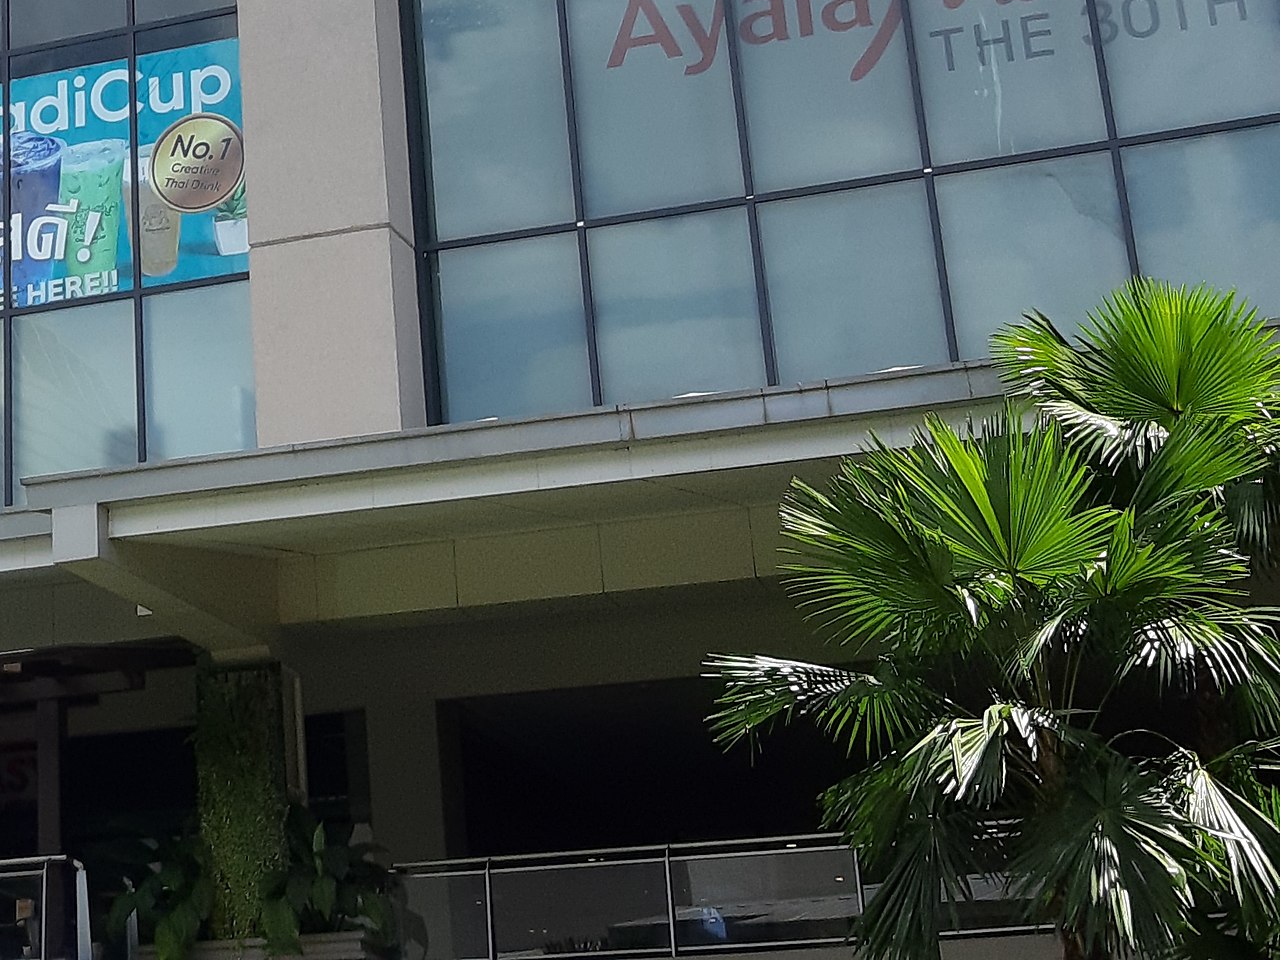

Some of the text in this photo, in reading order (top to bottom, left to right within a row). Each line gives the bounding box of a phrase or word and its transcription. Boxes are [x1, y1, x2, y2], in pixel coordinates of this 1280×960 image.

[929, 11, 1055, 72] THE
[171, 162, 220, 176] Creative
[164, 177, 188, 190] Thai
[26, 269, 119, 306] HERE!!
